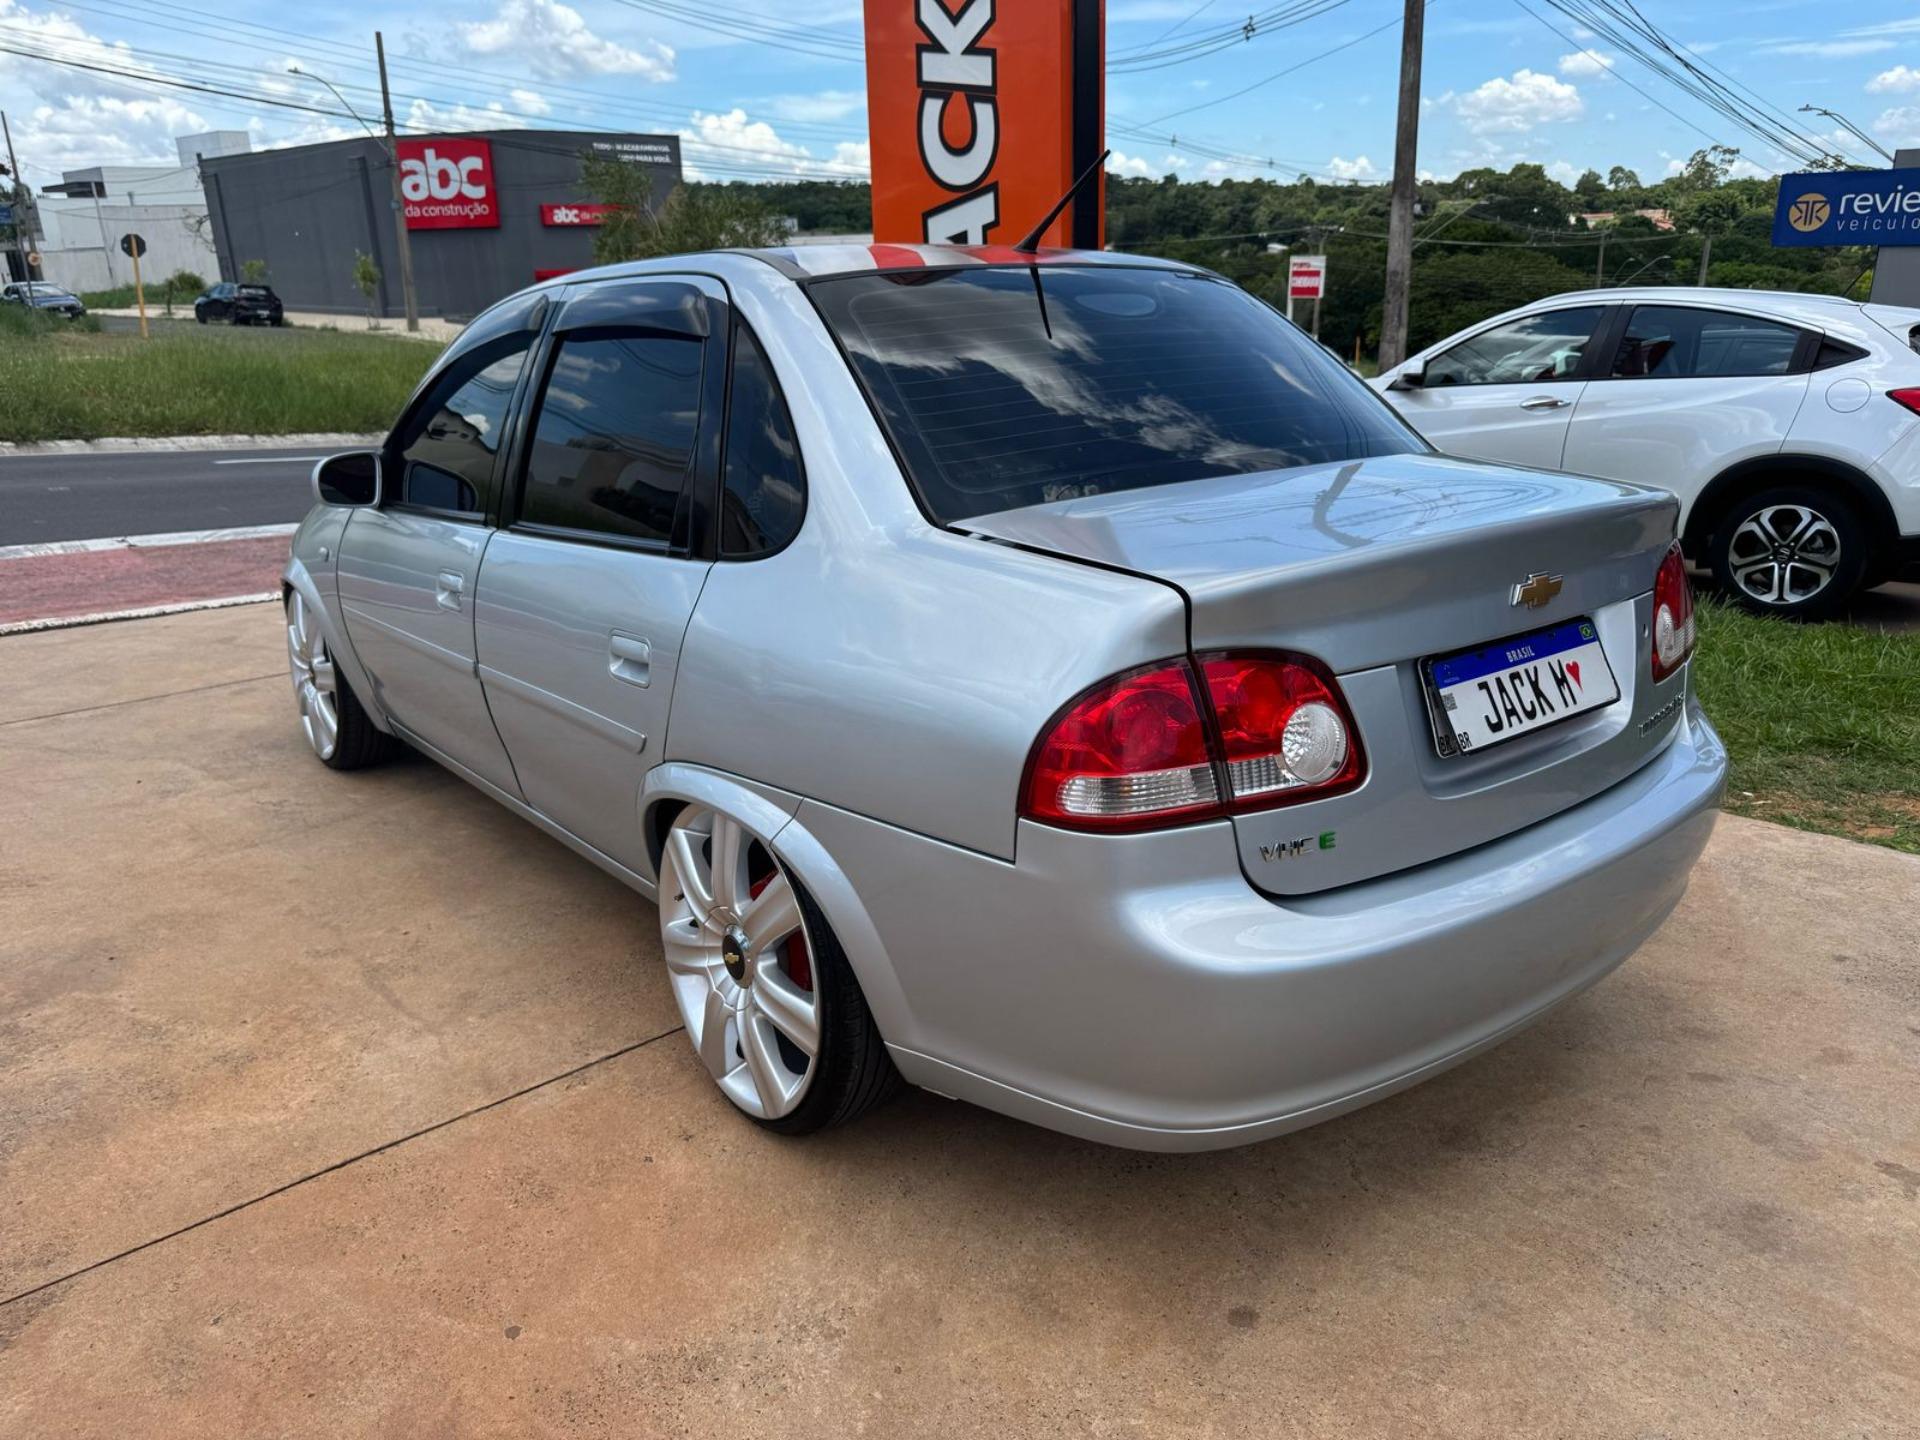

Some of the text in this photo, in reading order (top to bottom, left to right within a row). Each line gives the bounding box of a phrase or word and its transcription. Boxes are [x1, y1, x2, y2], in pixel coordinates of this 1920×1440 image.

[401, 148, 486, 201] abc
[405, 202, 489, 219] da construção
[553, 206, 580, 223] abc
[1505, 645, 1536, 663] BRASIL
[1477, 658, 1578, 733] JACK M
[1457, 731, 1473, 750] BR
[1319, 831, 1337, 850] E
